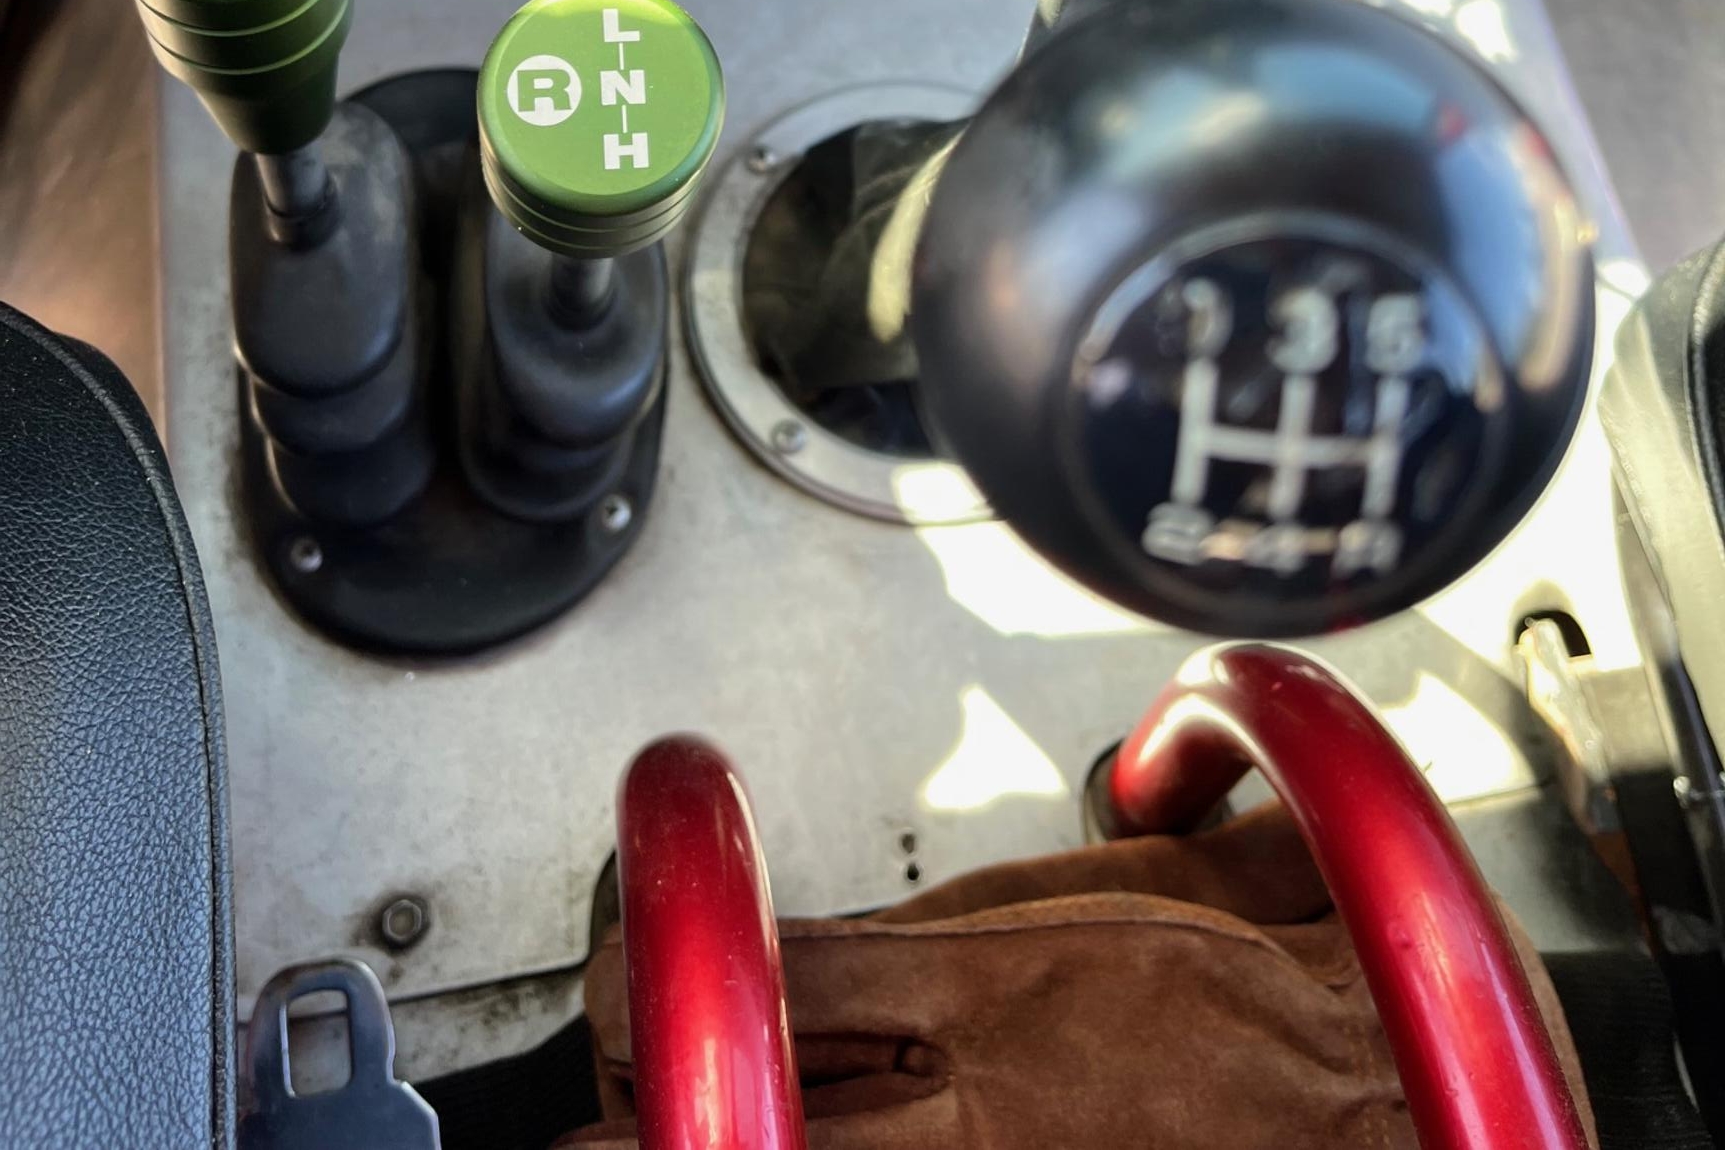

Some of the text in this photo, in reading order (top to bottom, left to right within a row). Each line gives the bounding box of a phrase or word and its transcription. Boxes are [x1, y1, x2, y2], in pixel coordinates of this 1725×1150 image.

[603, 9, 640, 42] L
[517, 68, 573, 113] R
[601, 69, 645, 105] N
[603, 132, 650, 170] H
[1268, 286, 1338, 375] 3
